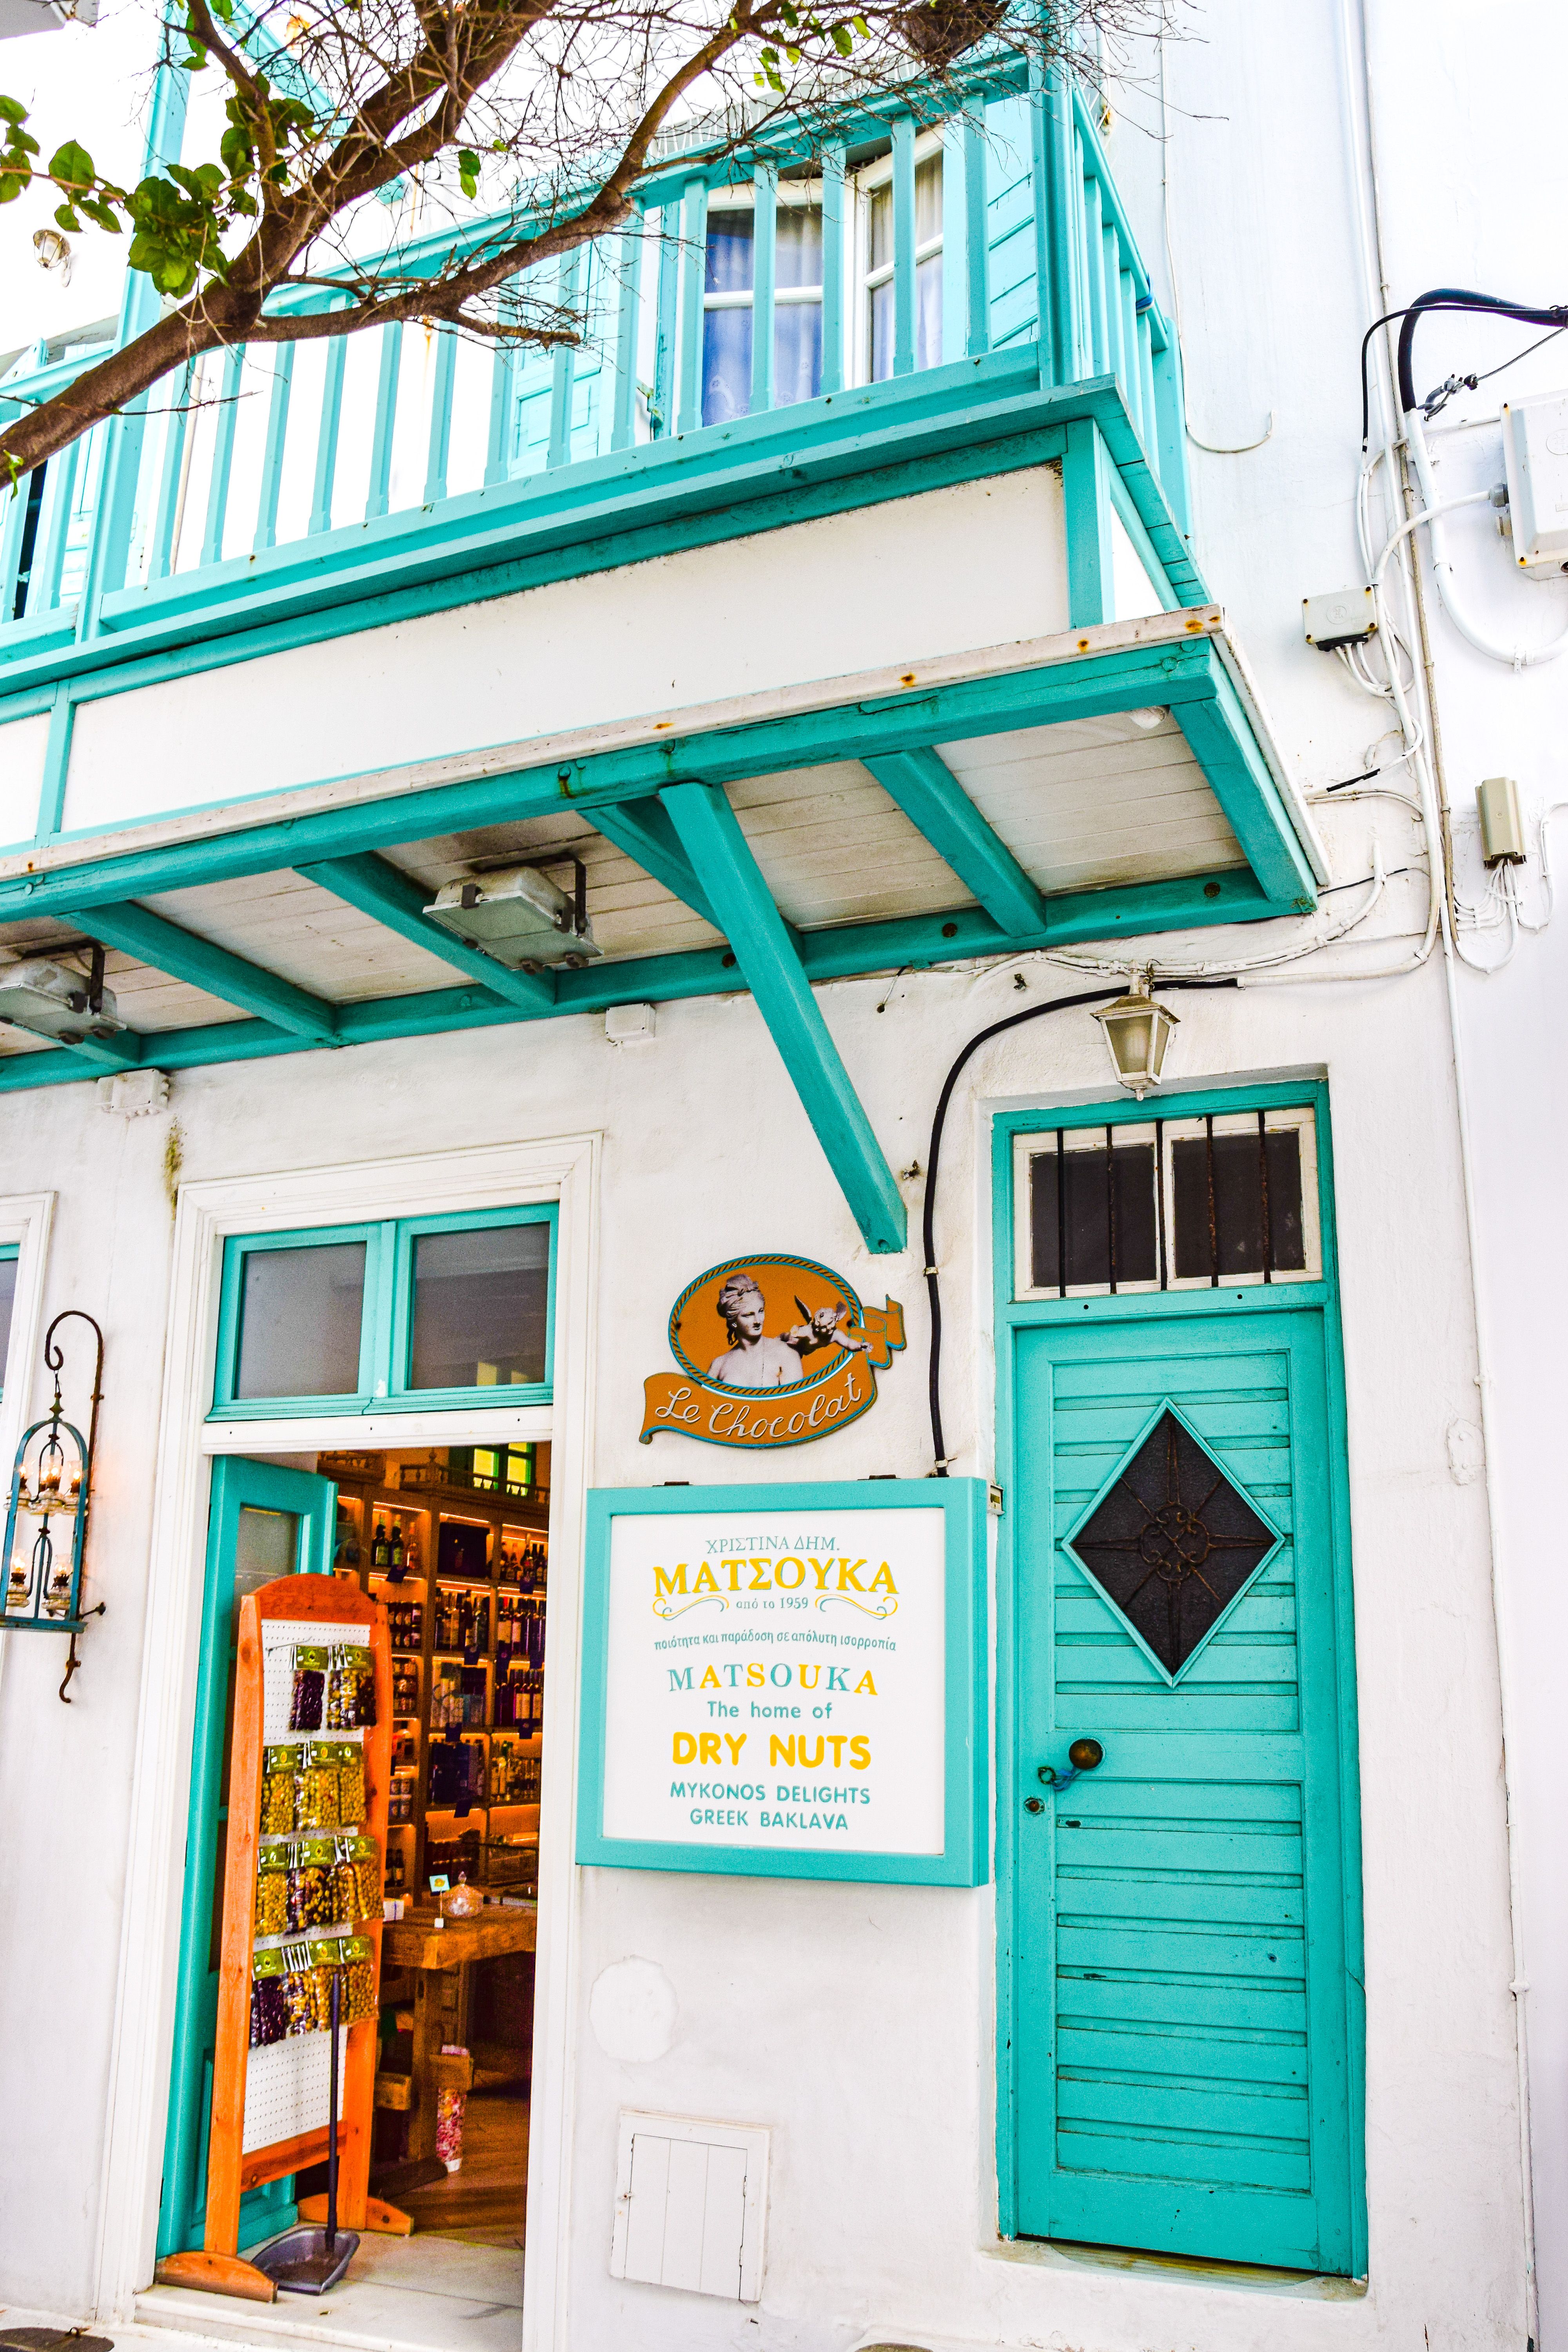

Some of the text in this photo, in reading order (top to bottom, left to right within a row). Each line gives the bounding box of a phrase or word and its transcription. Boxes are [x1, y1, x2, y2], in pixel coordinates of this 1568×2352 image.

[656, 1372, 862, 1438] Le Chocolat
[706, 1537, 839, 1554] ΧΡΙΣΤΙΝΑ ΔΗΜ.
[652, 1556, 899, 1597] ΜΑΤΣΟΥΚΑ
[736, 1597, 809, 1609] από το 1959
[654, 1629, 896, 1651] ποιότητα και παράδοση σε απόλυτη ισορροπία
[667, 1662, 878, 1696] MATSOUKA
[707, 1700, 832, 1719] The home of
[672, 1731, 871, 1771] DRY NUTS
[670, 1782, 870, 1804] MYKONOS DELIGHTS
[690, 1808, 848, 1830] GREEK BAKLAVA
